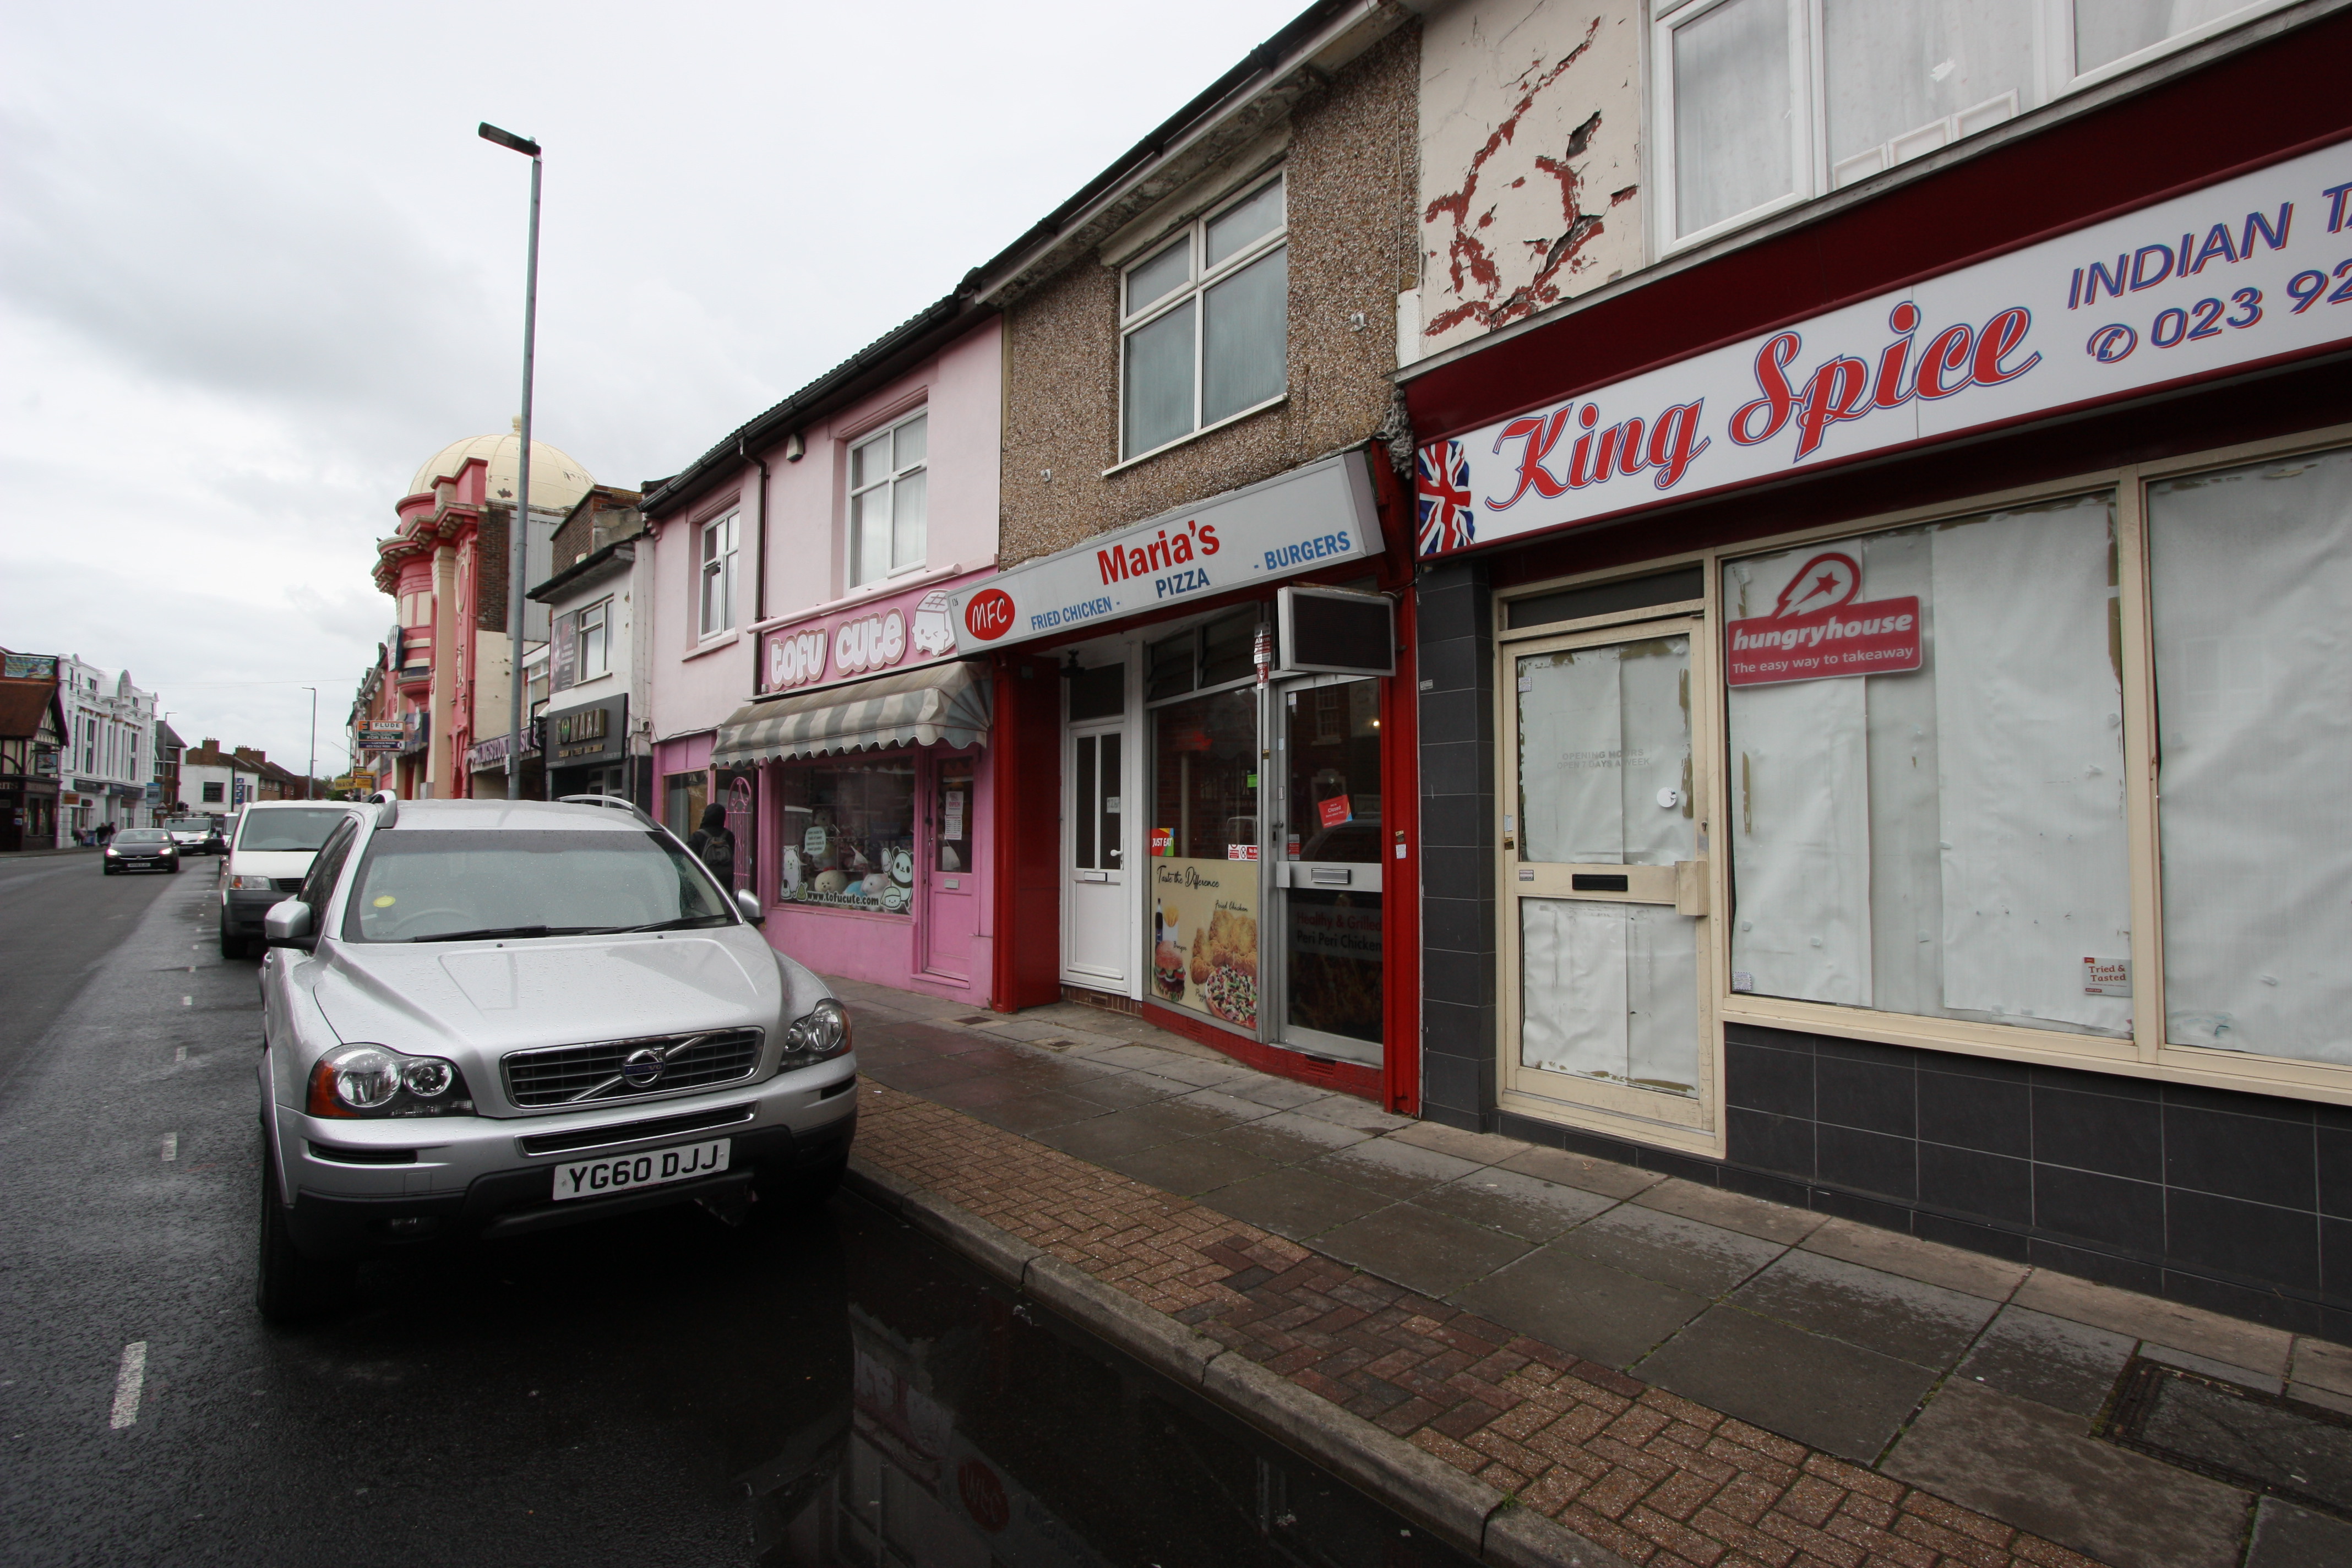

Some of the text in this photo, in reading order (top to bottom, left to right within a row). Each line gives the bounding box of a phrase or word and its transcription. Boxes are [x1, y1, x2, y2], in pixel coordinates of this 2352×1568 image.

[2067, 181, 2352, 311] INDIAN T
[2150, 286, 2263, 349] 023
[1485, 300, 2042, 513] King Spice
[1097, 520, 1220, 586] Maria's
[1264, 531, 1351, 570] BURGERS
[1155, 568, 1211, 598] PIZZA
[972, 598, 1007, 633] MFC
[1031, 610, 1061, 631] FRIED
[1062, 596, 1113, 622] CHICKEN
[1733, 614, 1913, 651] hungryhouse
[771, 610, 905, 688] tofu cute
[1733, 647, 1914, 674] The easy way to takeaway
[1557, 761, 1580, 770] OPEN
[1589, 760, 1613, 768] DAYS
[1625, 758, 1651, 766] WEEK
[1562, 749, 1644, 760] OPENING HOURS
[1327, 805, 1342, 813] Closed
[1152, 837, 1173, 847] JUST EAT
[1157, 865, 1220, 890] Taste the Difference
[807, 891, 879, 906] www.tofucute.com
[1215, 899, 1248, 912] Fried Chicken
[1297, 911, 1382, 932] Healthy & Grilled
[1297, 929, 1382, 952] Peri Peri Chicken
[2088, 964, 2126, 973] Tried &
[2090, 973, 2126, 982] Tasted
[569, 1144, 719, 1193] YG60 DJJ
